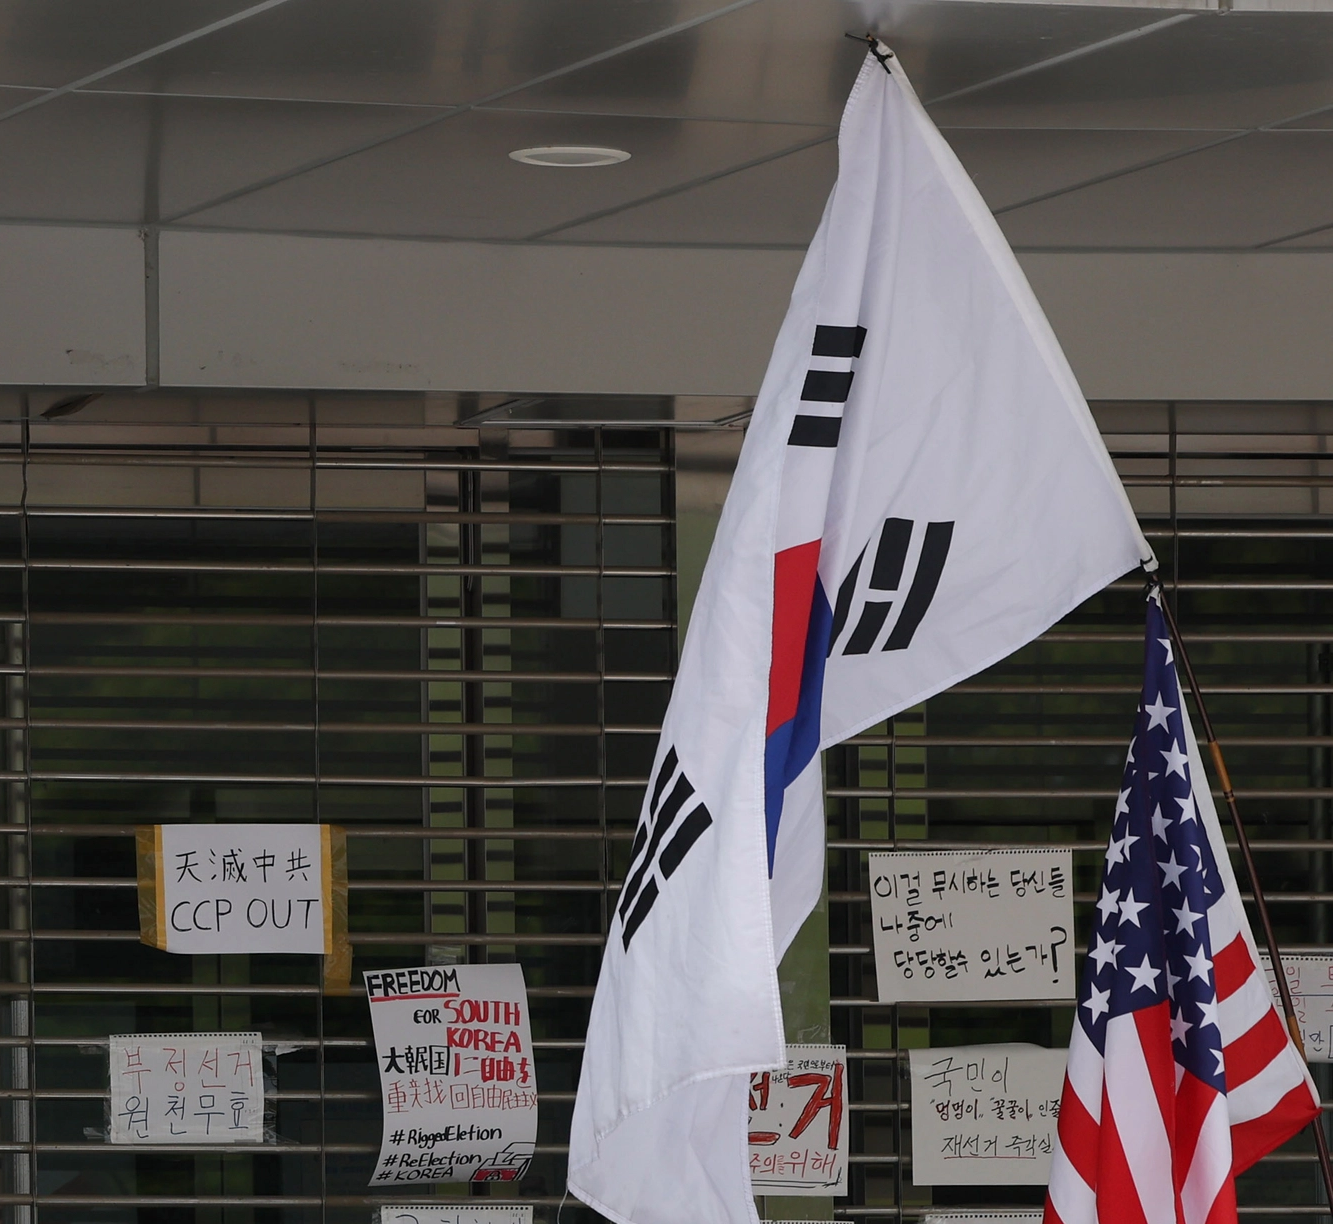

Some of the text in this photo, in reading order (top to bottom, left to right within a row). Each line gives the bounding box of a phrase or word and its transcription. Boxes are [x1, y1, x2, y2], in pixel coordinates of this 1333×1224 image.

[874, 867, 1066, 906] 이걸 무시하는 당신들
[171, 898, 319, 932] CCP OUT
[881, 910, 953, 942] 나중에
[367, 969, 461, 998] FREEDOM
[443, 999, 520, 1026] SOUTH
[447, 1027, 521, 1053] KOREA
[122, 1046, 253, 1094] 부정선거
[924, 1057, 1009, 1096] 국민이
[118, 1091, 249, 1139] 원천무효
[941, 1134, 998, 1157] 재선거
